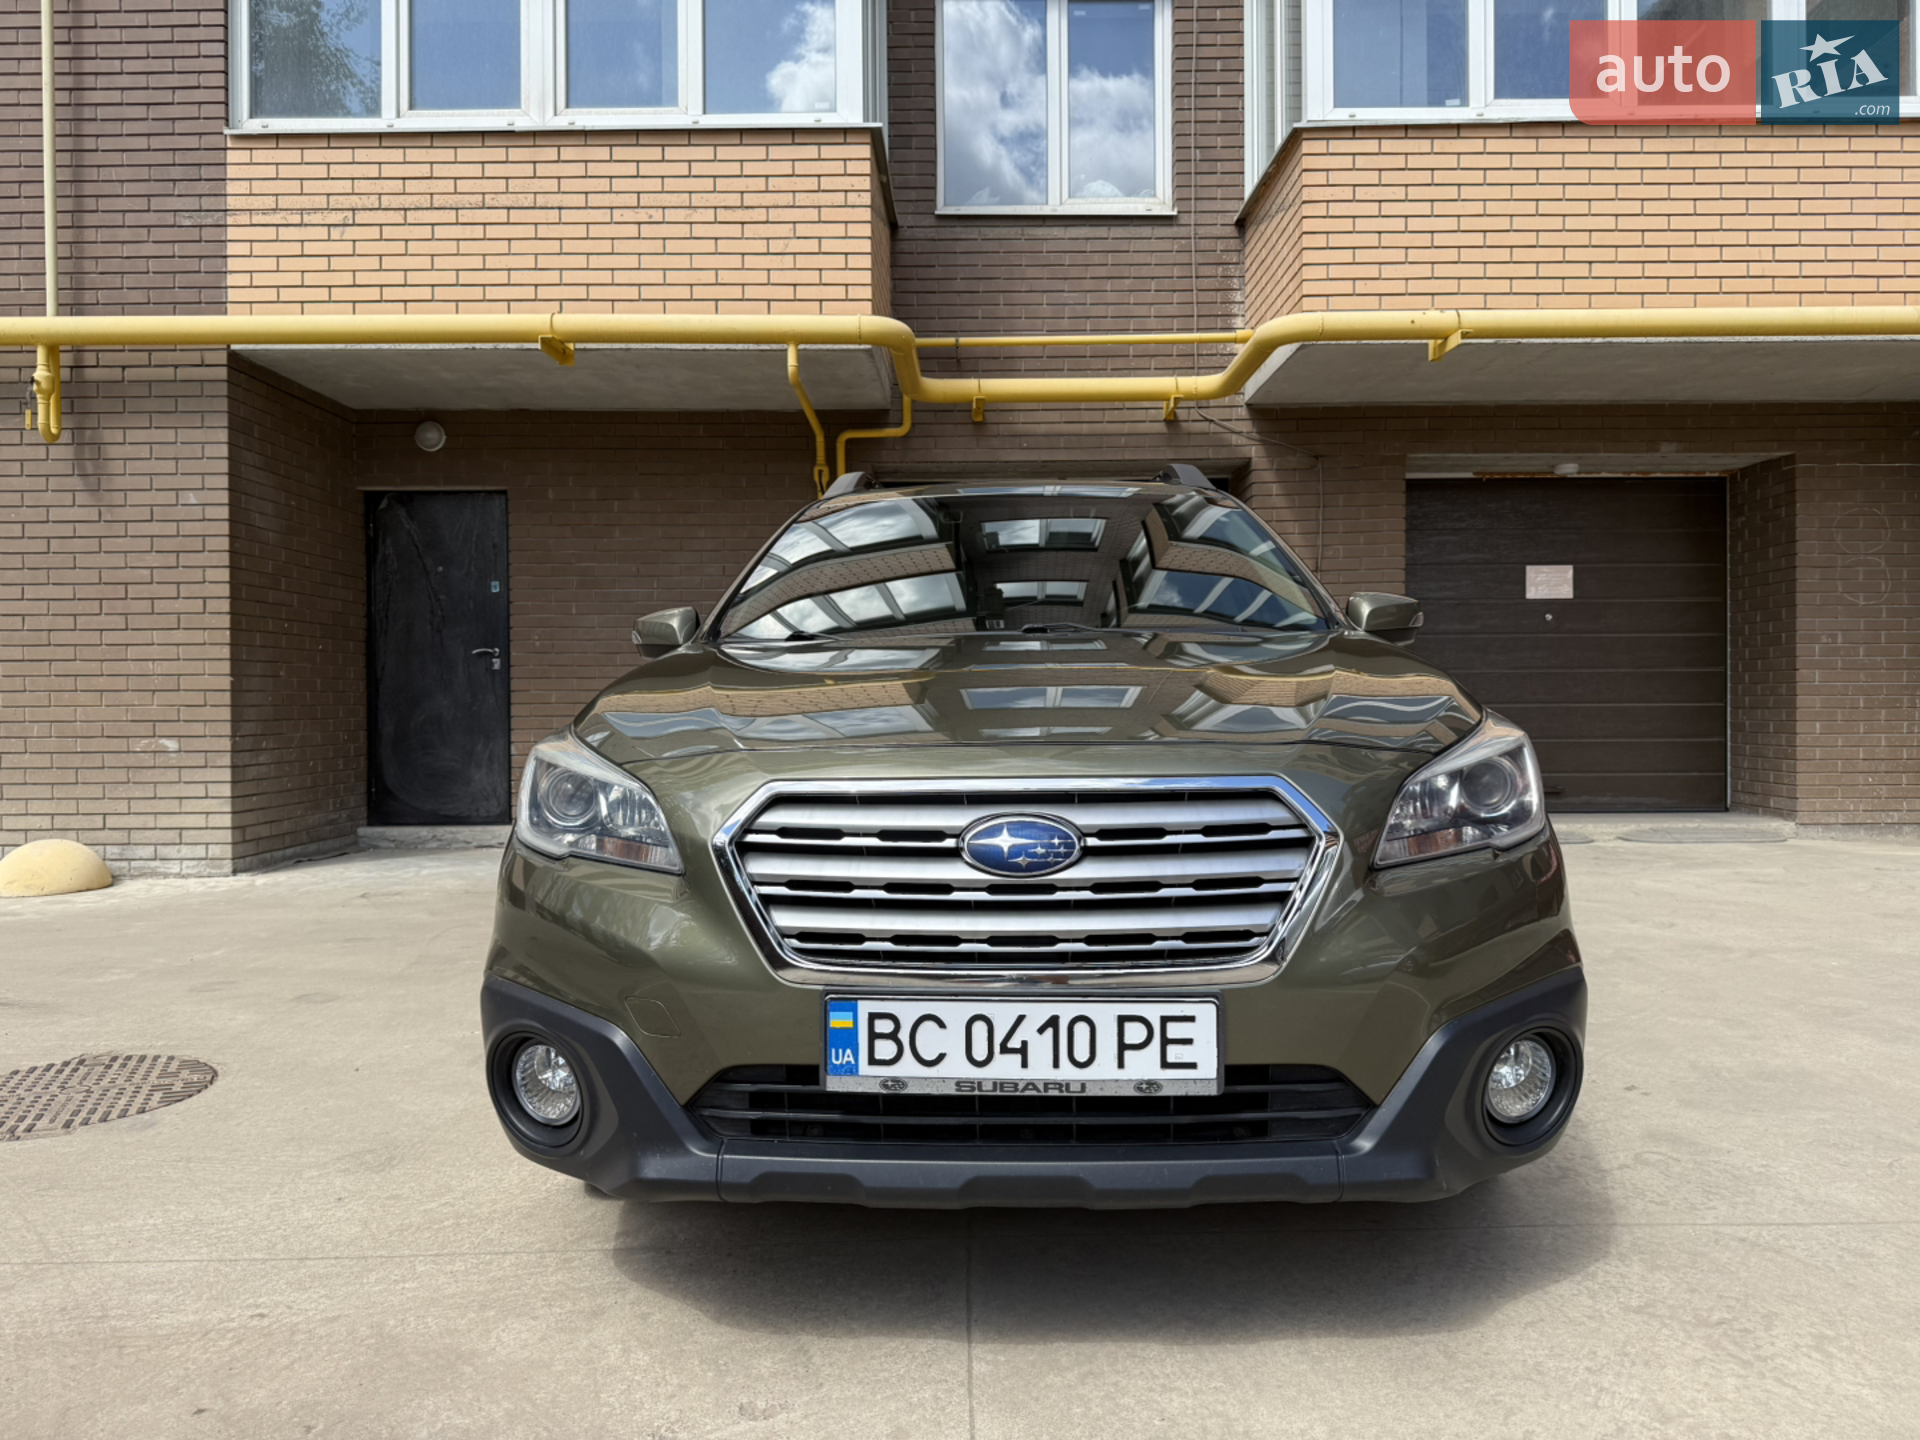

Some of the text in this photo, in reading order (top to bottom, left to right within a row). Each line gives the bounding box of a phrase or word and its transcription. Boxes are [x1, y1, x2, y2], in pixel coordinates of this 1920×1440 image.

[867, 1011, 1198, 1070] BC 0410 PE
[831, 1048, 856, 1065] UA
[954, 1080, 1087, 1095] SUBARU
